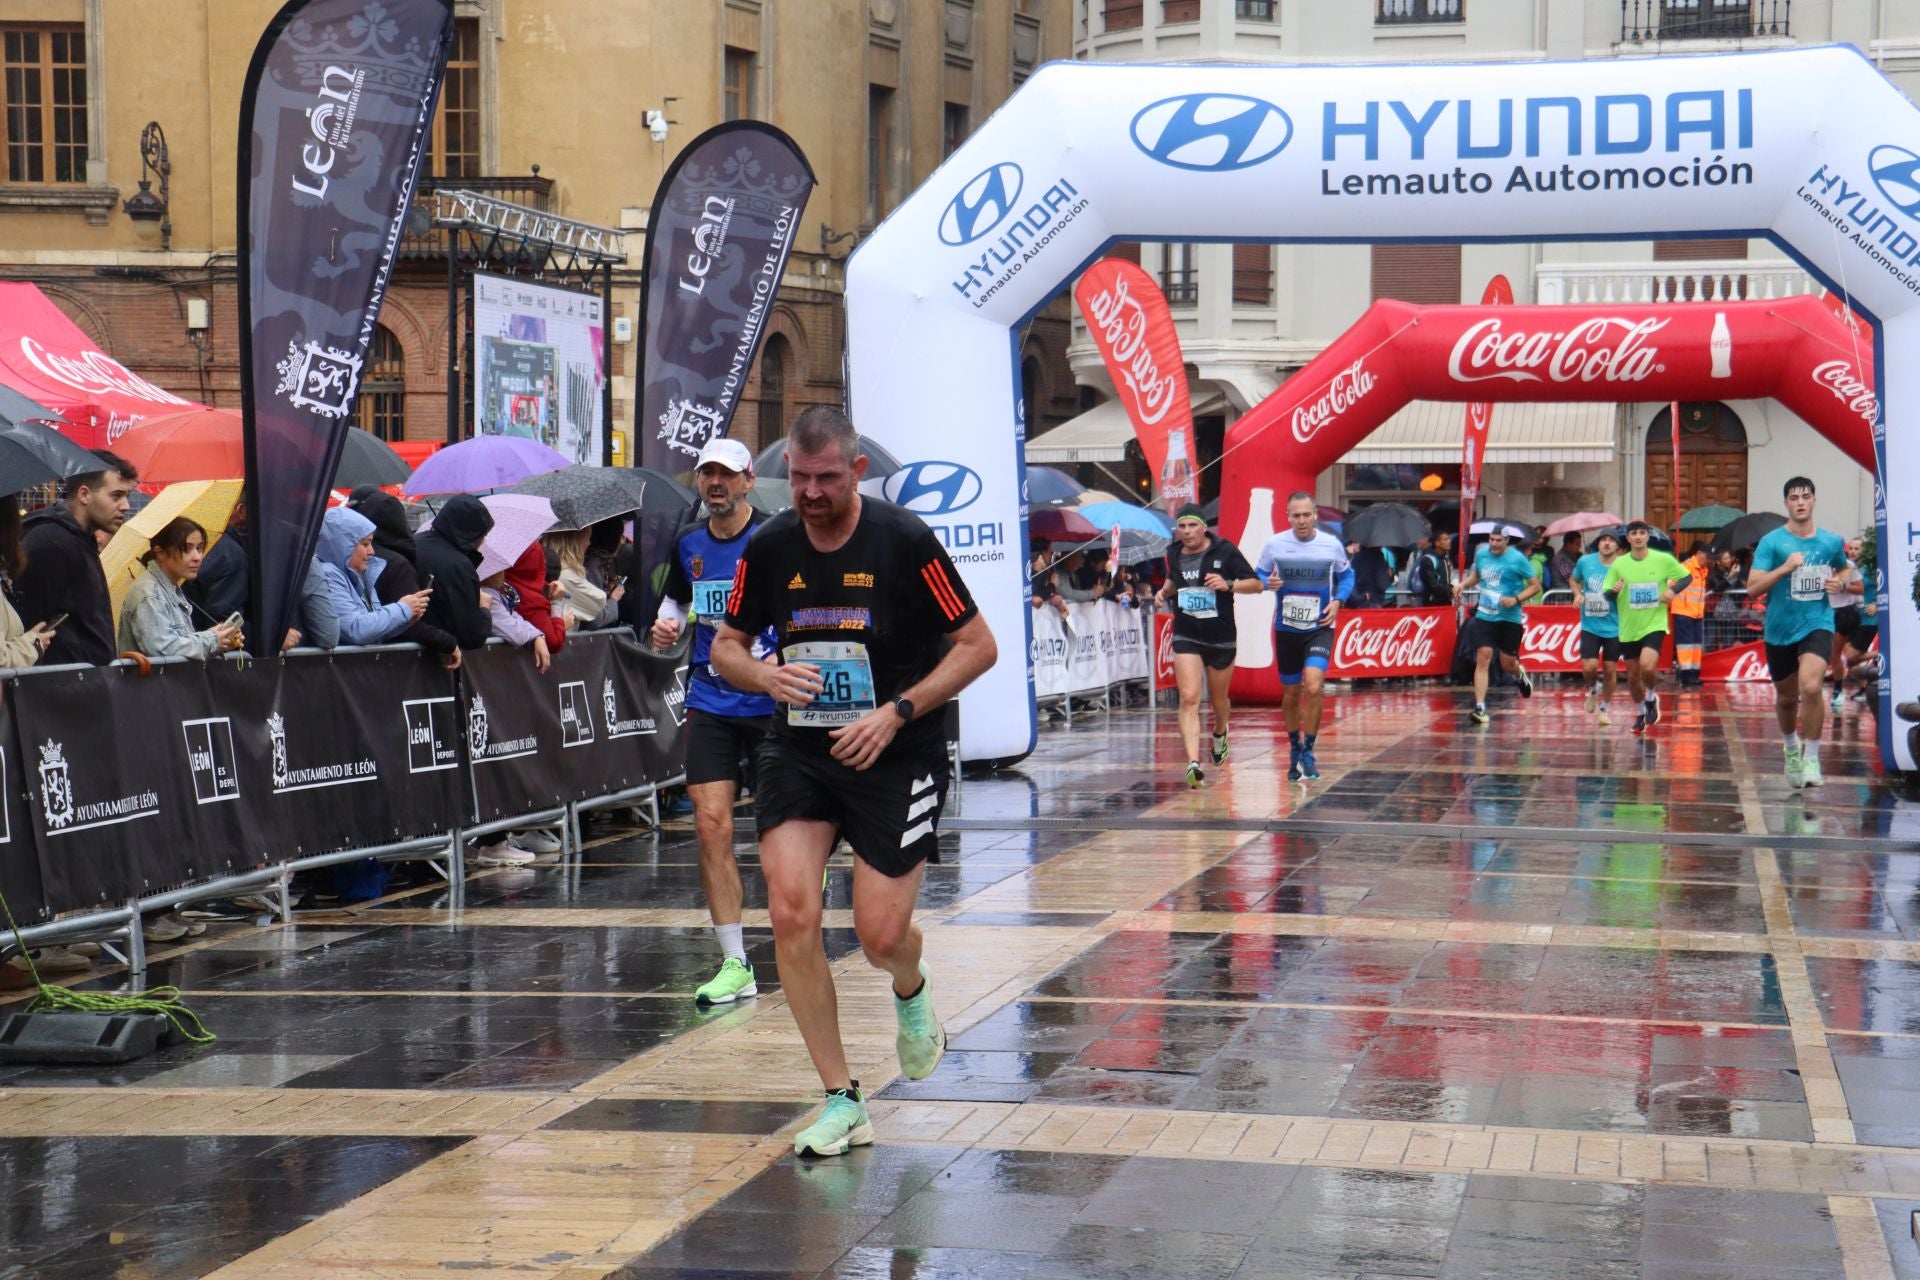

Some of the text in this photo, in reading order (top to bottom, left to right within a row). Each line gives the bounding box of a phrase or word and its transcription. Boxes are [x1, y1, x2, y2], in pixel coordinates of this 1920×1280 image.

[1322, 88, 1753, 161] HYUNDAI
[1322, 156, 1753, 196] Lemauto Automoción
[1796, 186, 1850, 234] Lemauto
[1808, 164, 1920, 275] HYUND
[952, 178, 1079, 299] HYUNDAI
[972, 198, 1089, 309] Lemauto Automoción
[719, 206, 793, 408] AYUNTAMIENTO DE LEÓN
[1449, 317, 1672, 384] Coca-Cola
[20, 336, 192, 407] Coca-Cola
[1292, 358, 1377, 443] Coca-Cola
[1812, 360, 1876, 426] Coca-Co
[1694, 410, 1701, 421] 9
[930, 522, 1004, 548] NDAI
[950, 550, 1005, 564] omoción
[1636, 591, 1652, 601] 635
[1800, 577, 1821, 592] 1016
[839, 619, 866, 630] 2022
[1290, 607, 1311, 620] 687
[1333, 615, 1440, 669] Coca-Cola
[666, 687, 685, 706] LEÓN
[819, 711, 861, 721] HYUNDAI
[410, 721, 431, 745] LEÓN
[436, 741, 442, 749] ES
[191, 745, 212, 772] LEÓN
[217, 766, 226, 776] ES
[287, 757, 377, 784] AYUNTAMIENTO DE LEÓN
[140, 789, 159, 808] LEÓN
